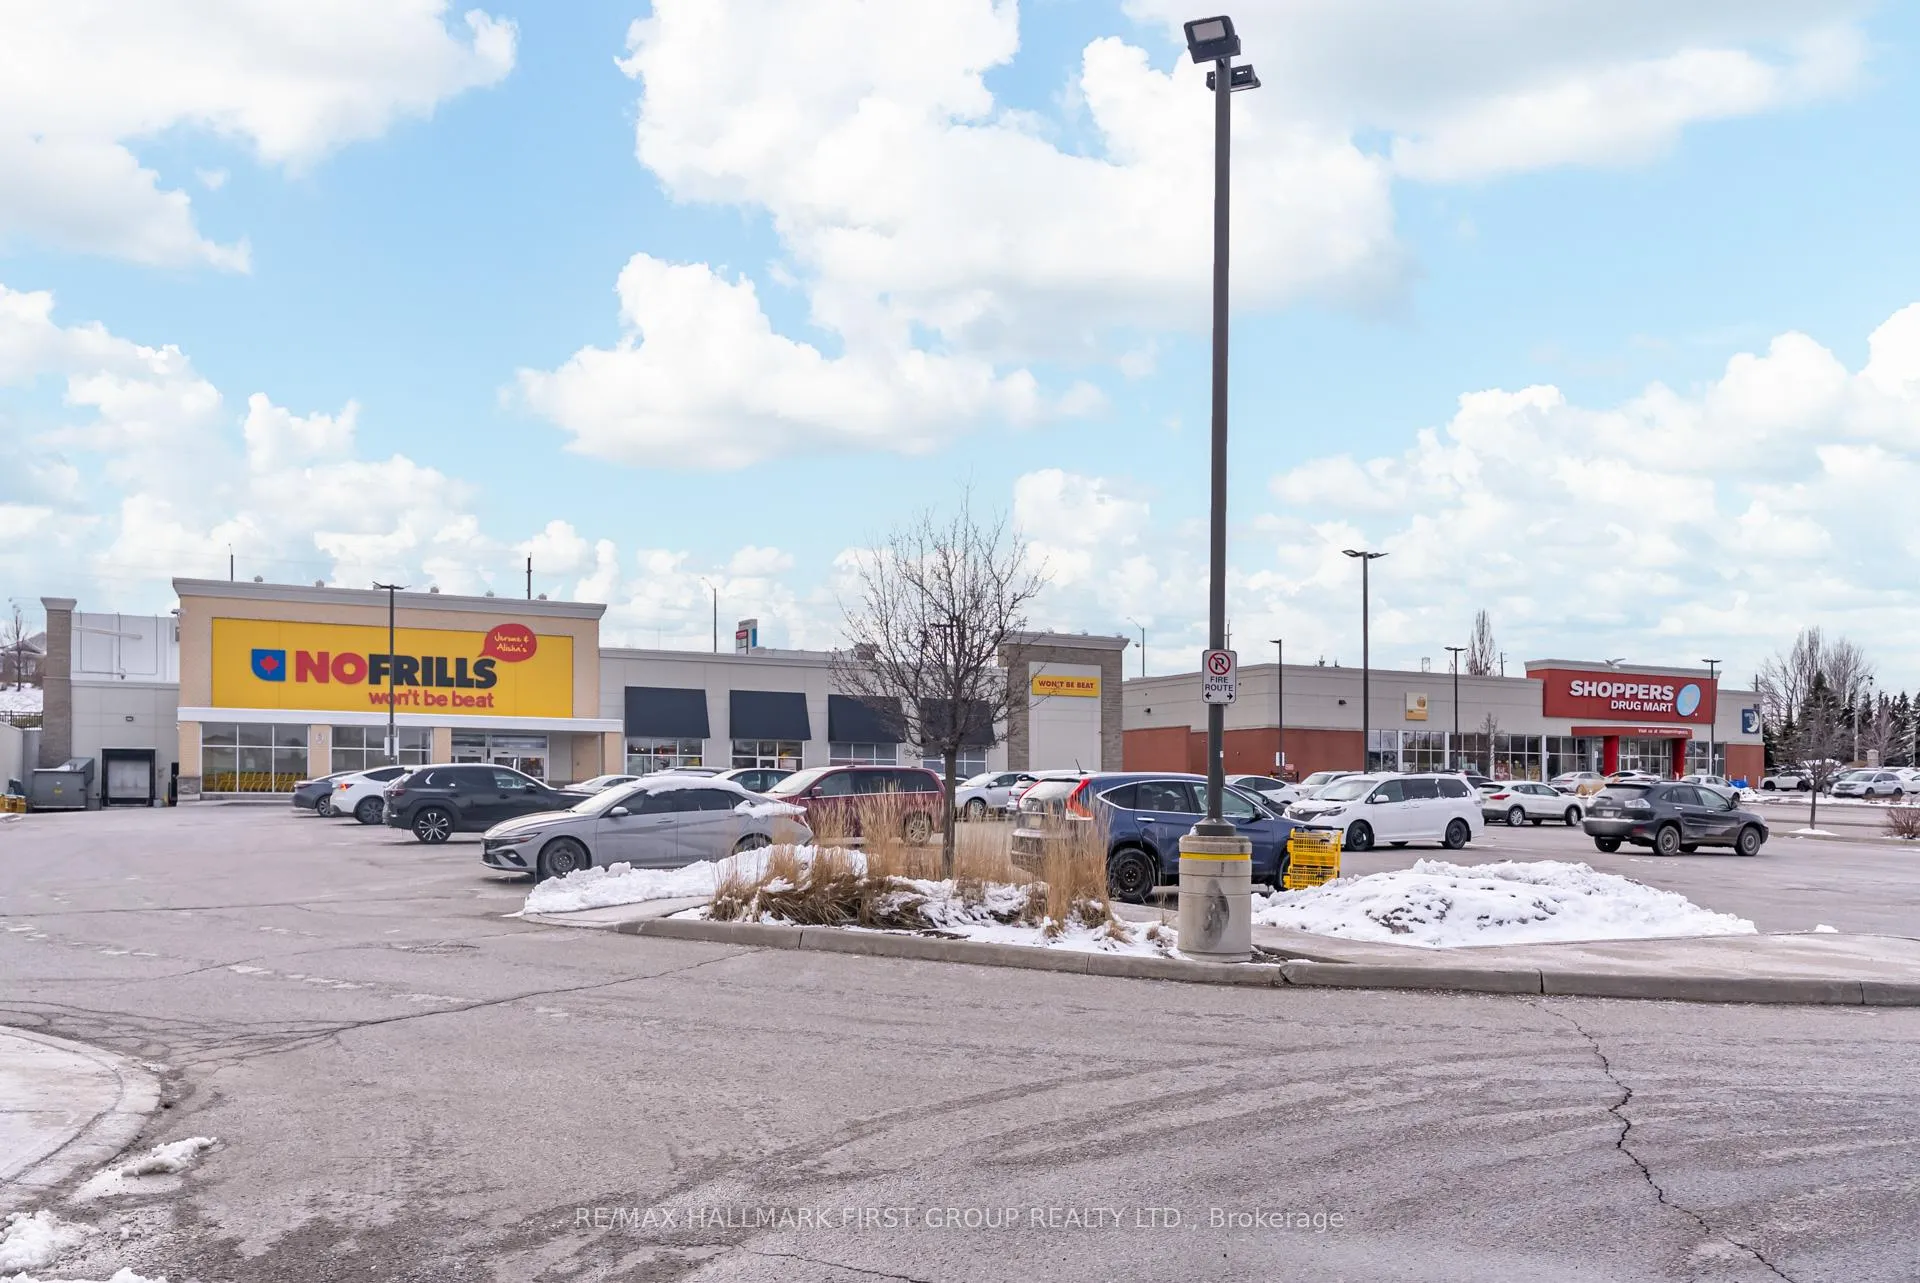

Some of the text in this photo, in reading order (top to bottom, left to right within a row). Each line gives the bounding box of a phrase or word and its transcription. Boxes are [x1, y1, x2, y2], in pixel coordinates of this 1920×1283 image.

[1065, 681, 1075, 689] BE
[1076, 681, 1094, 689] BEAT
[1210, 676, 1229, 684] FIRE
[1204, 683, 1234, 692] ROUTE
[1569, 679, 1675, 701] SHOPPERS
[424, 689, 449, 707] be
[452, 690, 494, 708] beat
[1611, 700, 1673, 713] DRUG MART
